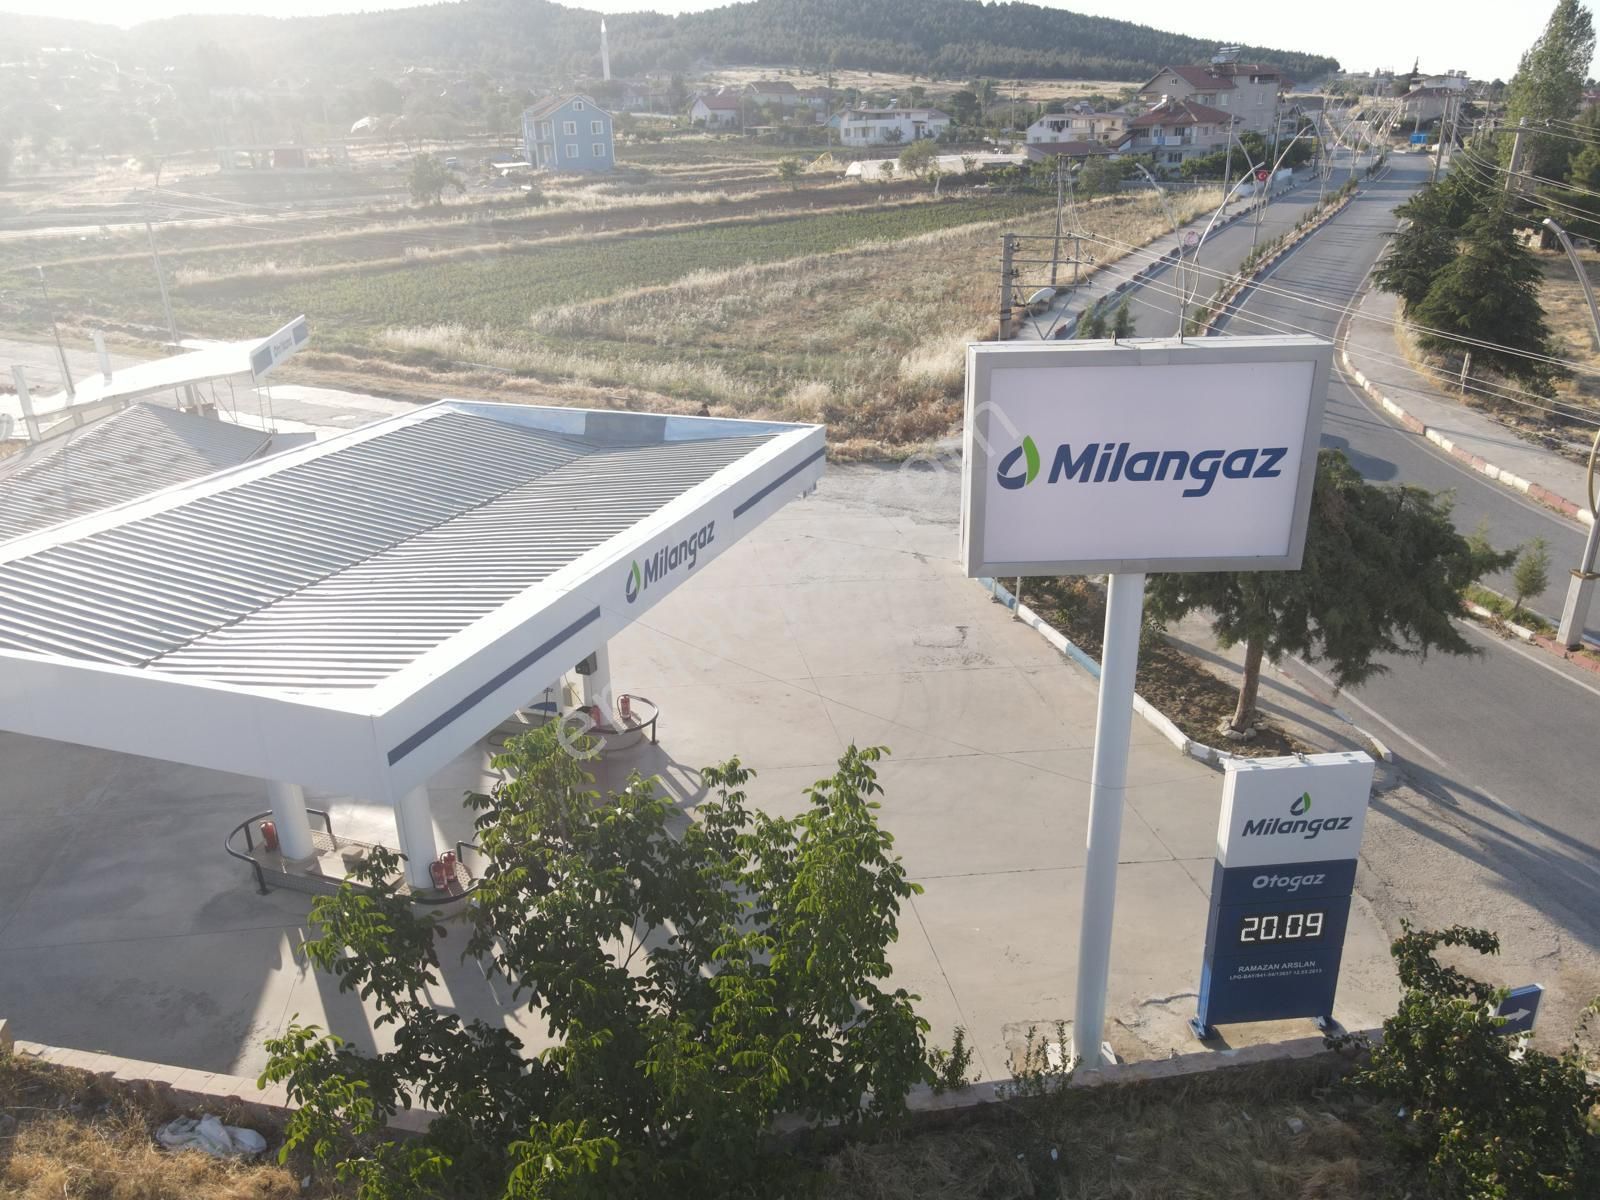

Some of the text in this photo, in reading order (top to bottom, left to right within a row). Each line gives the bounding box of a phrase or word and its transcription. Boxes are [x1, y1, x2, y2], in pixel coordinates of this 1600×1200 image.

[1047, 442, 1289, 498] Milangaz
[644, 520, 715, 591] Milangaz
[1241, 816, 1353, 840] Milangaz
[1252, 873, 1326, 892] Otogaz
[1240, 912, 1324, 942] 20.09
[1238, 960, 1316, 973] RAMAZAN ARSLAN
